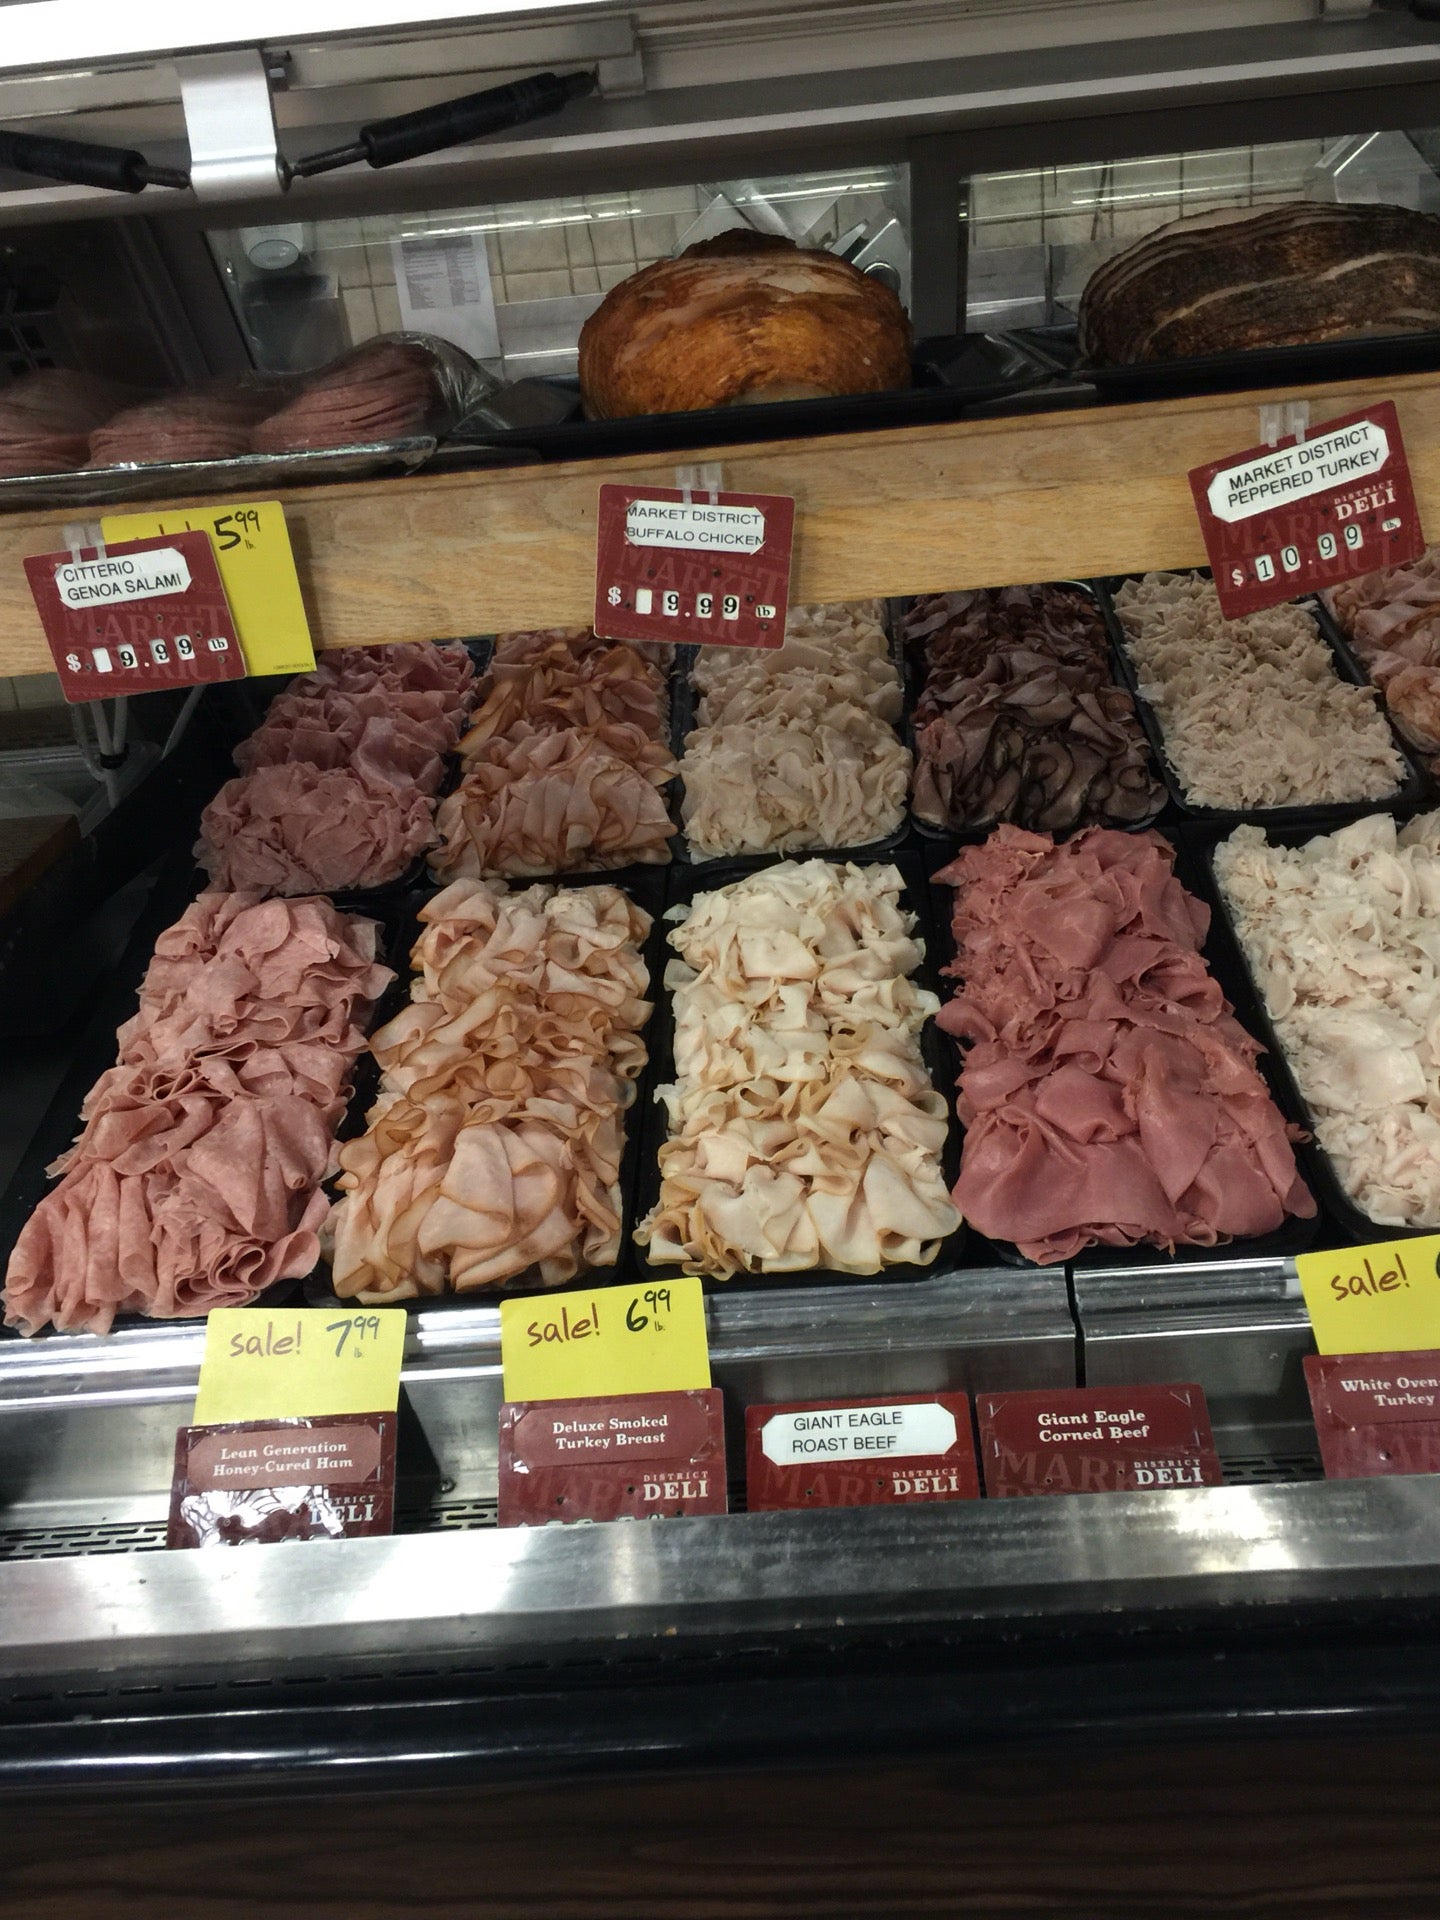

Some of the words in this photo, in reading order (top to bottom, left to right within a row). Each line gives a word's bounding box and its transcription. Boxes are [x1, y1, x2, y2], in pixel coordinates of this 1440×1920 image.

[1229, 455, 1294, 490] MARKET
[1299, 426, 1370, 465] DISTRICT
[1228, 470, 1314, 508] PEPPERED
[1317, 448, 1380, 480] TURKEY
[1334, 480, 1394, 504] DISTRICT
[1335, 488, 1396, 520] DELI
[627, 506, 688, 520] MARKET
[692, 510, 761, 525] DISTRICT
[627, 527, 694, 541] BUFFALO
[698, 532, 764, 546] CHICKEN
[63, 561, 135, 582] CITTERIO
[67, 580, 122, 601] GENOA
[125, 573, 182, 593] SALAMI
[757, 606, 771, 617] lb
[211, 639, 225, 650] lb
[1331, 1252, 1410, 1301] sale!
[527, 1302, 600, 1347] sale!
[229, 1321, 301, 1357] sale!
[1340, 1378, 1392, 1392] White
[1373, 1393, 1435, 1406] Turkey
[553, 1421, 604, 1434] Deluxe
[609, 1415, 668, 1429] Smoked
[794, 1415, 843, 1431] GIANT
[849, 1411, 903, 1427] EAGLE
[1037, 1413, 1088, 1426] Giant
[1094, 1409, 1145, 1425] Eagle
[556, 1436, 611, 1450] Turkey
[616, 1432, 666, 1446] Breast
[1039, 1427, 1103, 1442] Corned
[1110, 1425, 1150, 1440] Beef
[221, 1448, 257, 1460] Lean
[263, 1441, 348, 1457] Generation
[792, 1438, 848, 1453] ROAST
[854, 1436, 897, 1450] BEEF
[213, 1459, 311, 1477] Honey-Cured
[316, 1457, 353, 1470] Ham
[892, 1468, 958, 1477] DISTRICT
[1134, 1459, 1200, 1469] DISTRICT
[643, 1471, 709, 1482] DISTRICT
[893, 1476, 959, 1495] DELI
[1135, 1468, 1204, 1485] DELI
[643, 1480, 709, 1501] DELI
